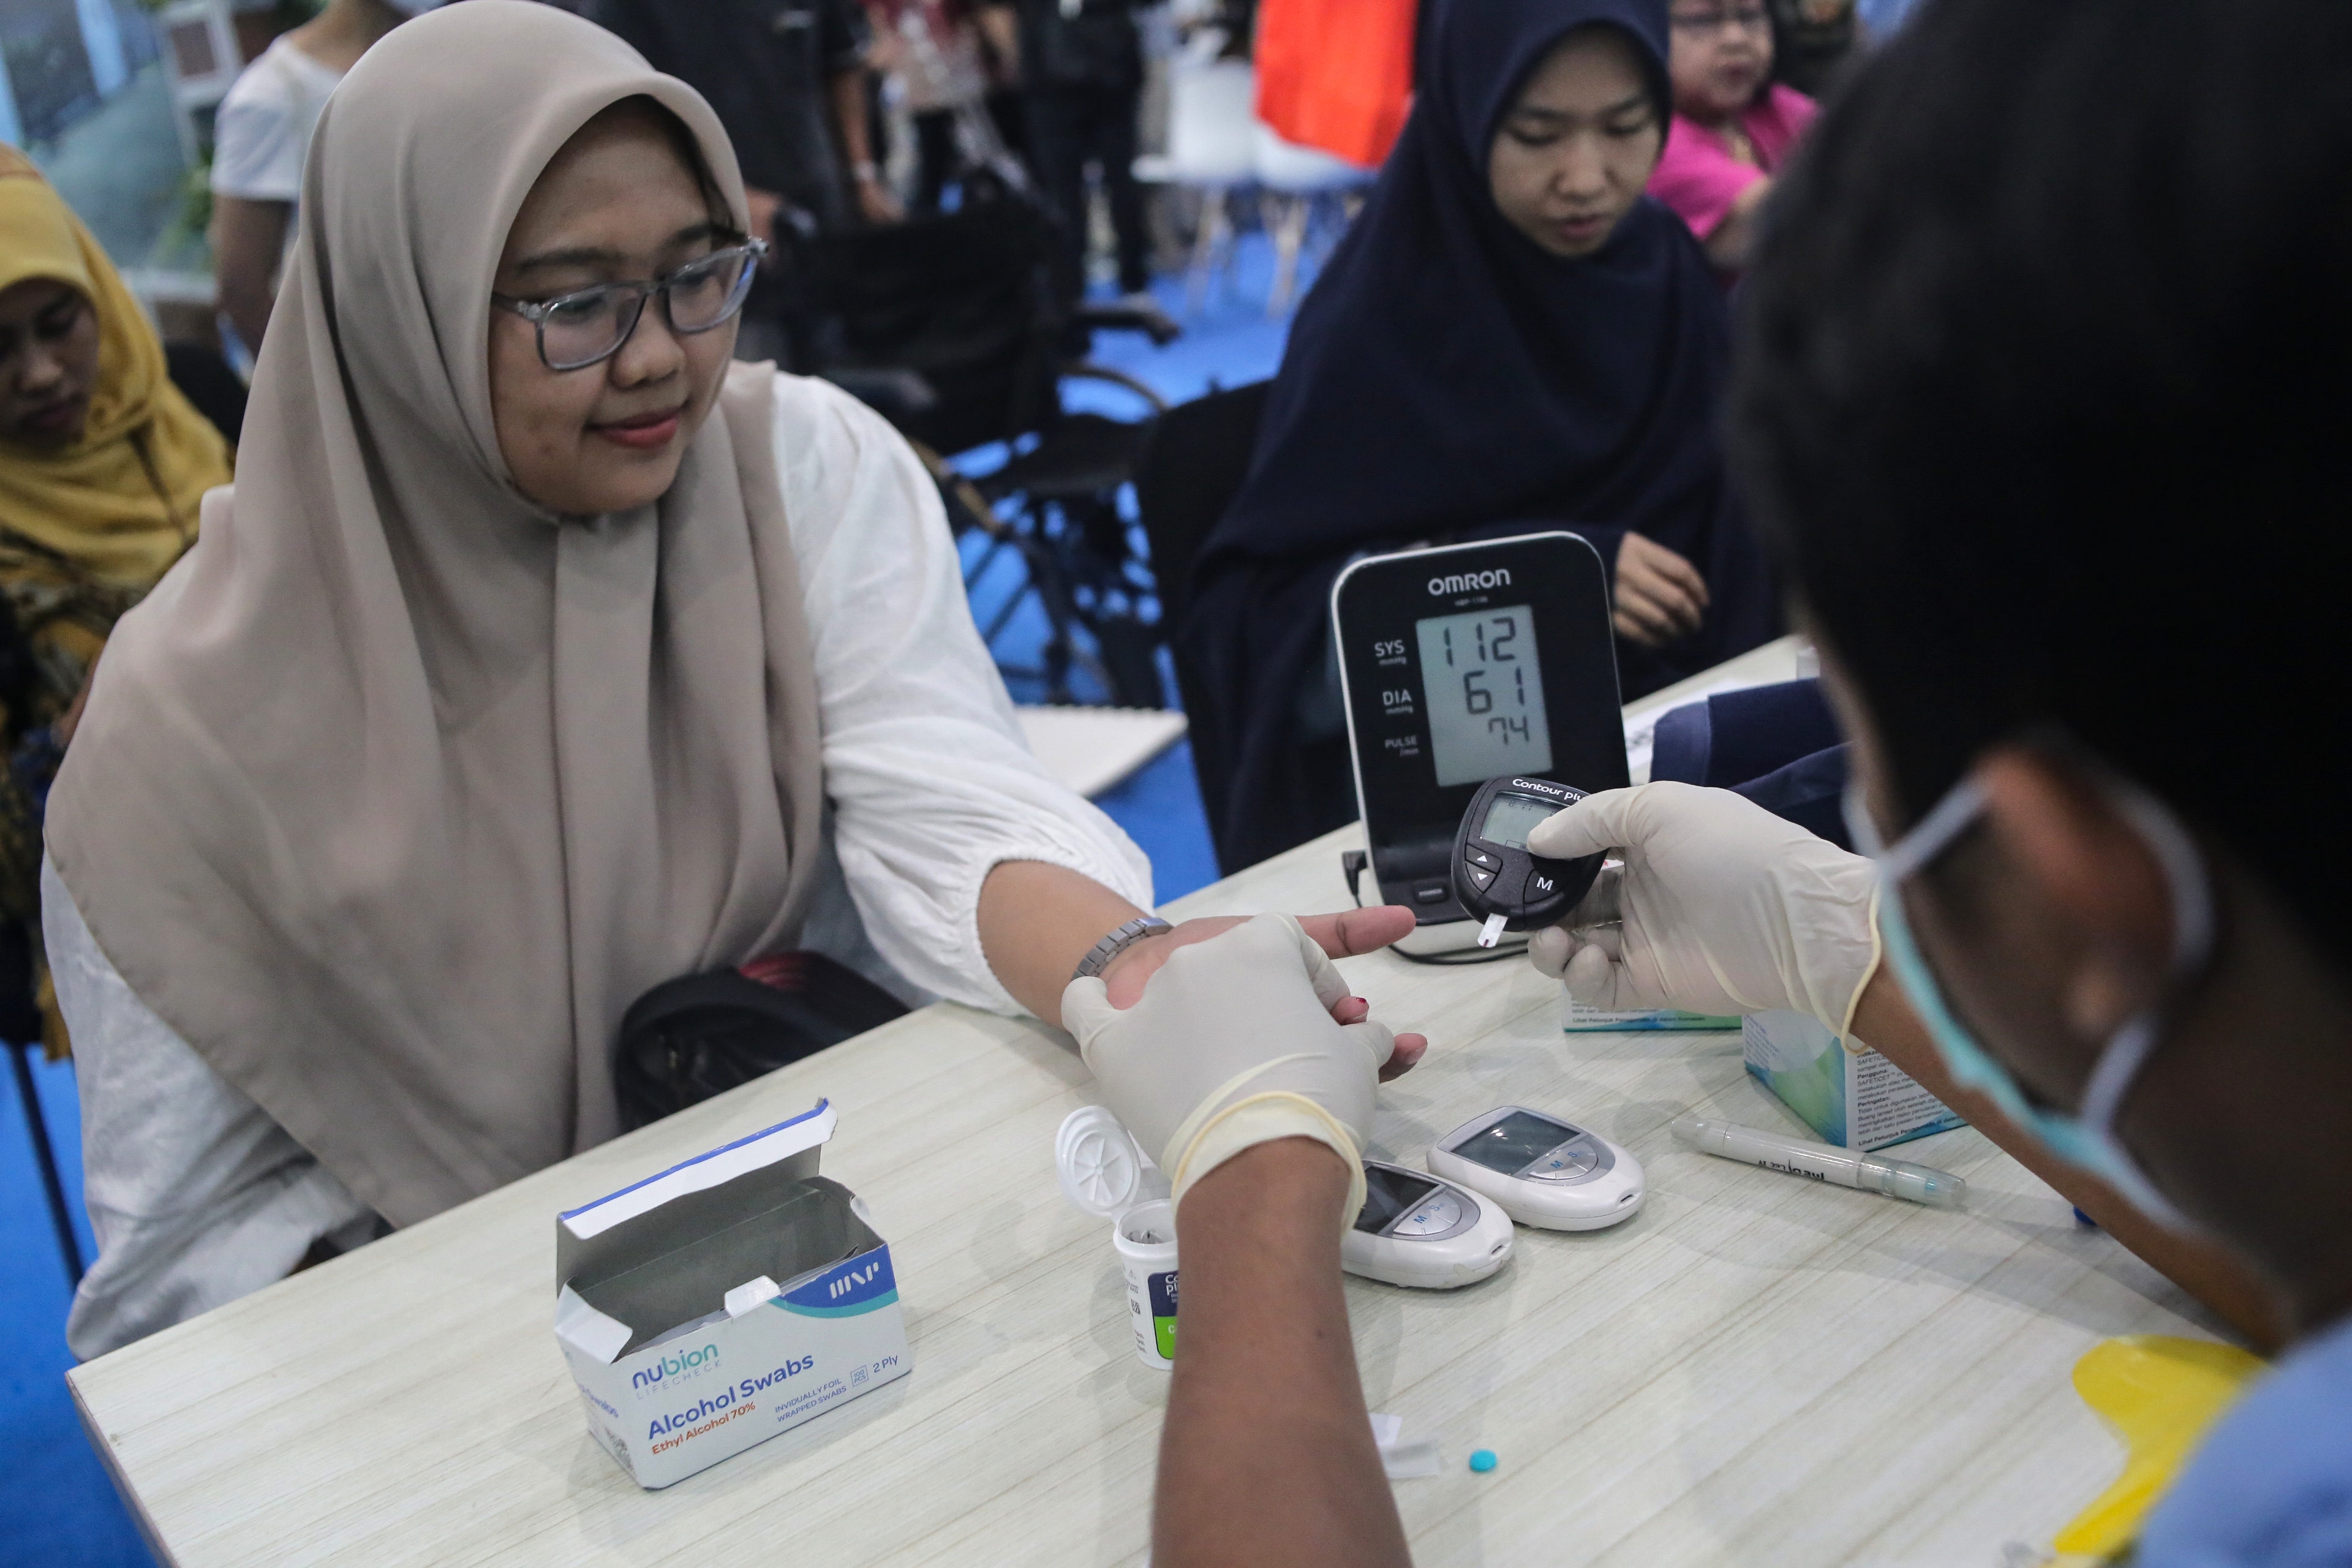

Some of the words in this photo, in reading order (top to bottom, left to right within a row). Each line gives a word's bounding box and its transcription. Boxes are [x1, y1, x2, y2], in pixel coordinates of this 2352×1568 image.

[1428, 568, 1511, 595] OMRON
[1374, 639, 1404, 657] SYS
[1444, 616, 1516, 666] 112
[1382, 688, 1412, 706] DIA
[1463, 666, 1525, 715] 61
[1385, 736, 1417, 748] PULSE
[1488, 715, 1529, 745] 74
[1512, 778, 1564, 796] Contour
[1537, 876, 1553, 891] M
[1550, 1159, 1564, 1169] M
[1414, 1215, 1427, 1224] M
[632, 1343, 718, 1389] nubion
[873, 1363, 881, 1373] 2
[881, 1355, 899, 1368] Ply
[636, 1359, 722, 1401] LIFECHECK
[648, 1385, 736, 1441] Alcohol
[740, 1355, 814, 1398] Swabs
[775, 1385, 823, 1413] INVIDUALLY
[823, 1378, 842, 1390] FOIL
[777, 1400, 817, 1422] WRAPPED
[818, 1385, 847, 1403] SWABS
[652, 1433, 684, 1455] Ethyl
[685, 1413, 730, 1441] Alcohol
[731, 1401, 756, 1420] 70%
